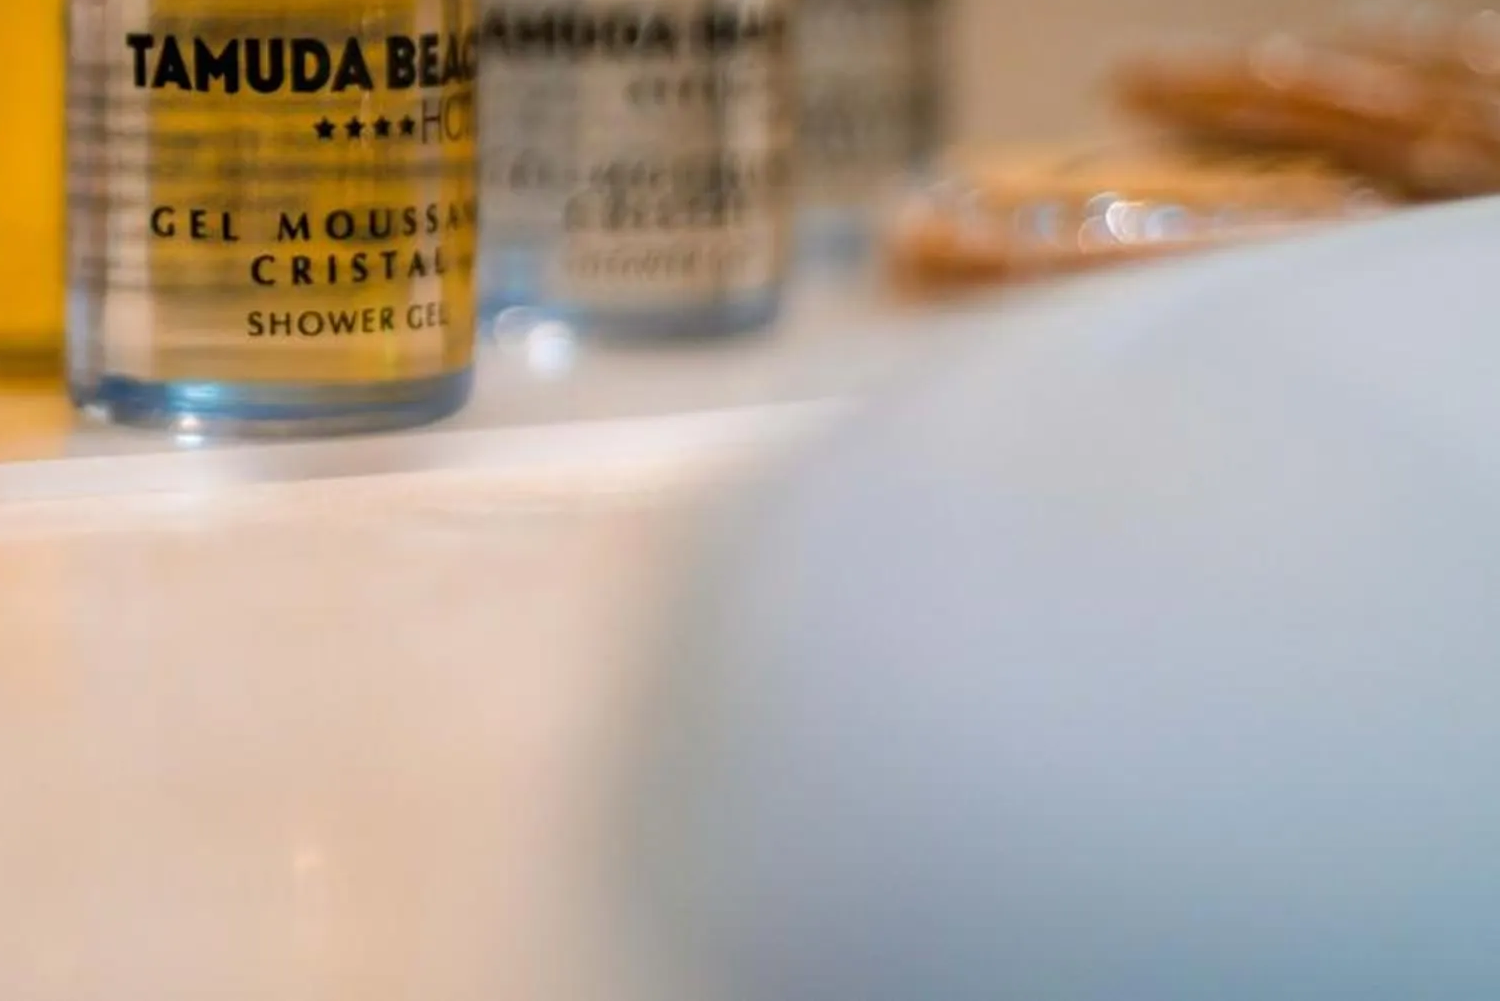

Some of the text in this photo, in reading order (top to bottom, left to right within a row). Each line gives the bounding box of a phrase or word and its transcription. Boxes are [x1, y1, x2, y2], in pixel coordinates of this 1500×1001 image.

[126, 27, 479, 94] TAMUDA BEAC
[150, 205, 239, 243] GEL
[250, 246, 447, 286] CRISTAL
[247, 301, 450, 337] SHOWER GEL
